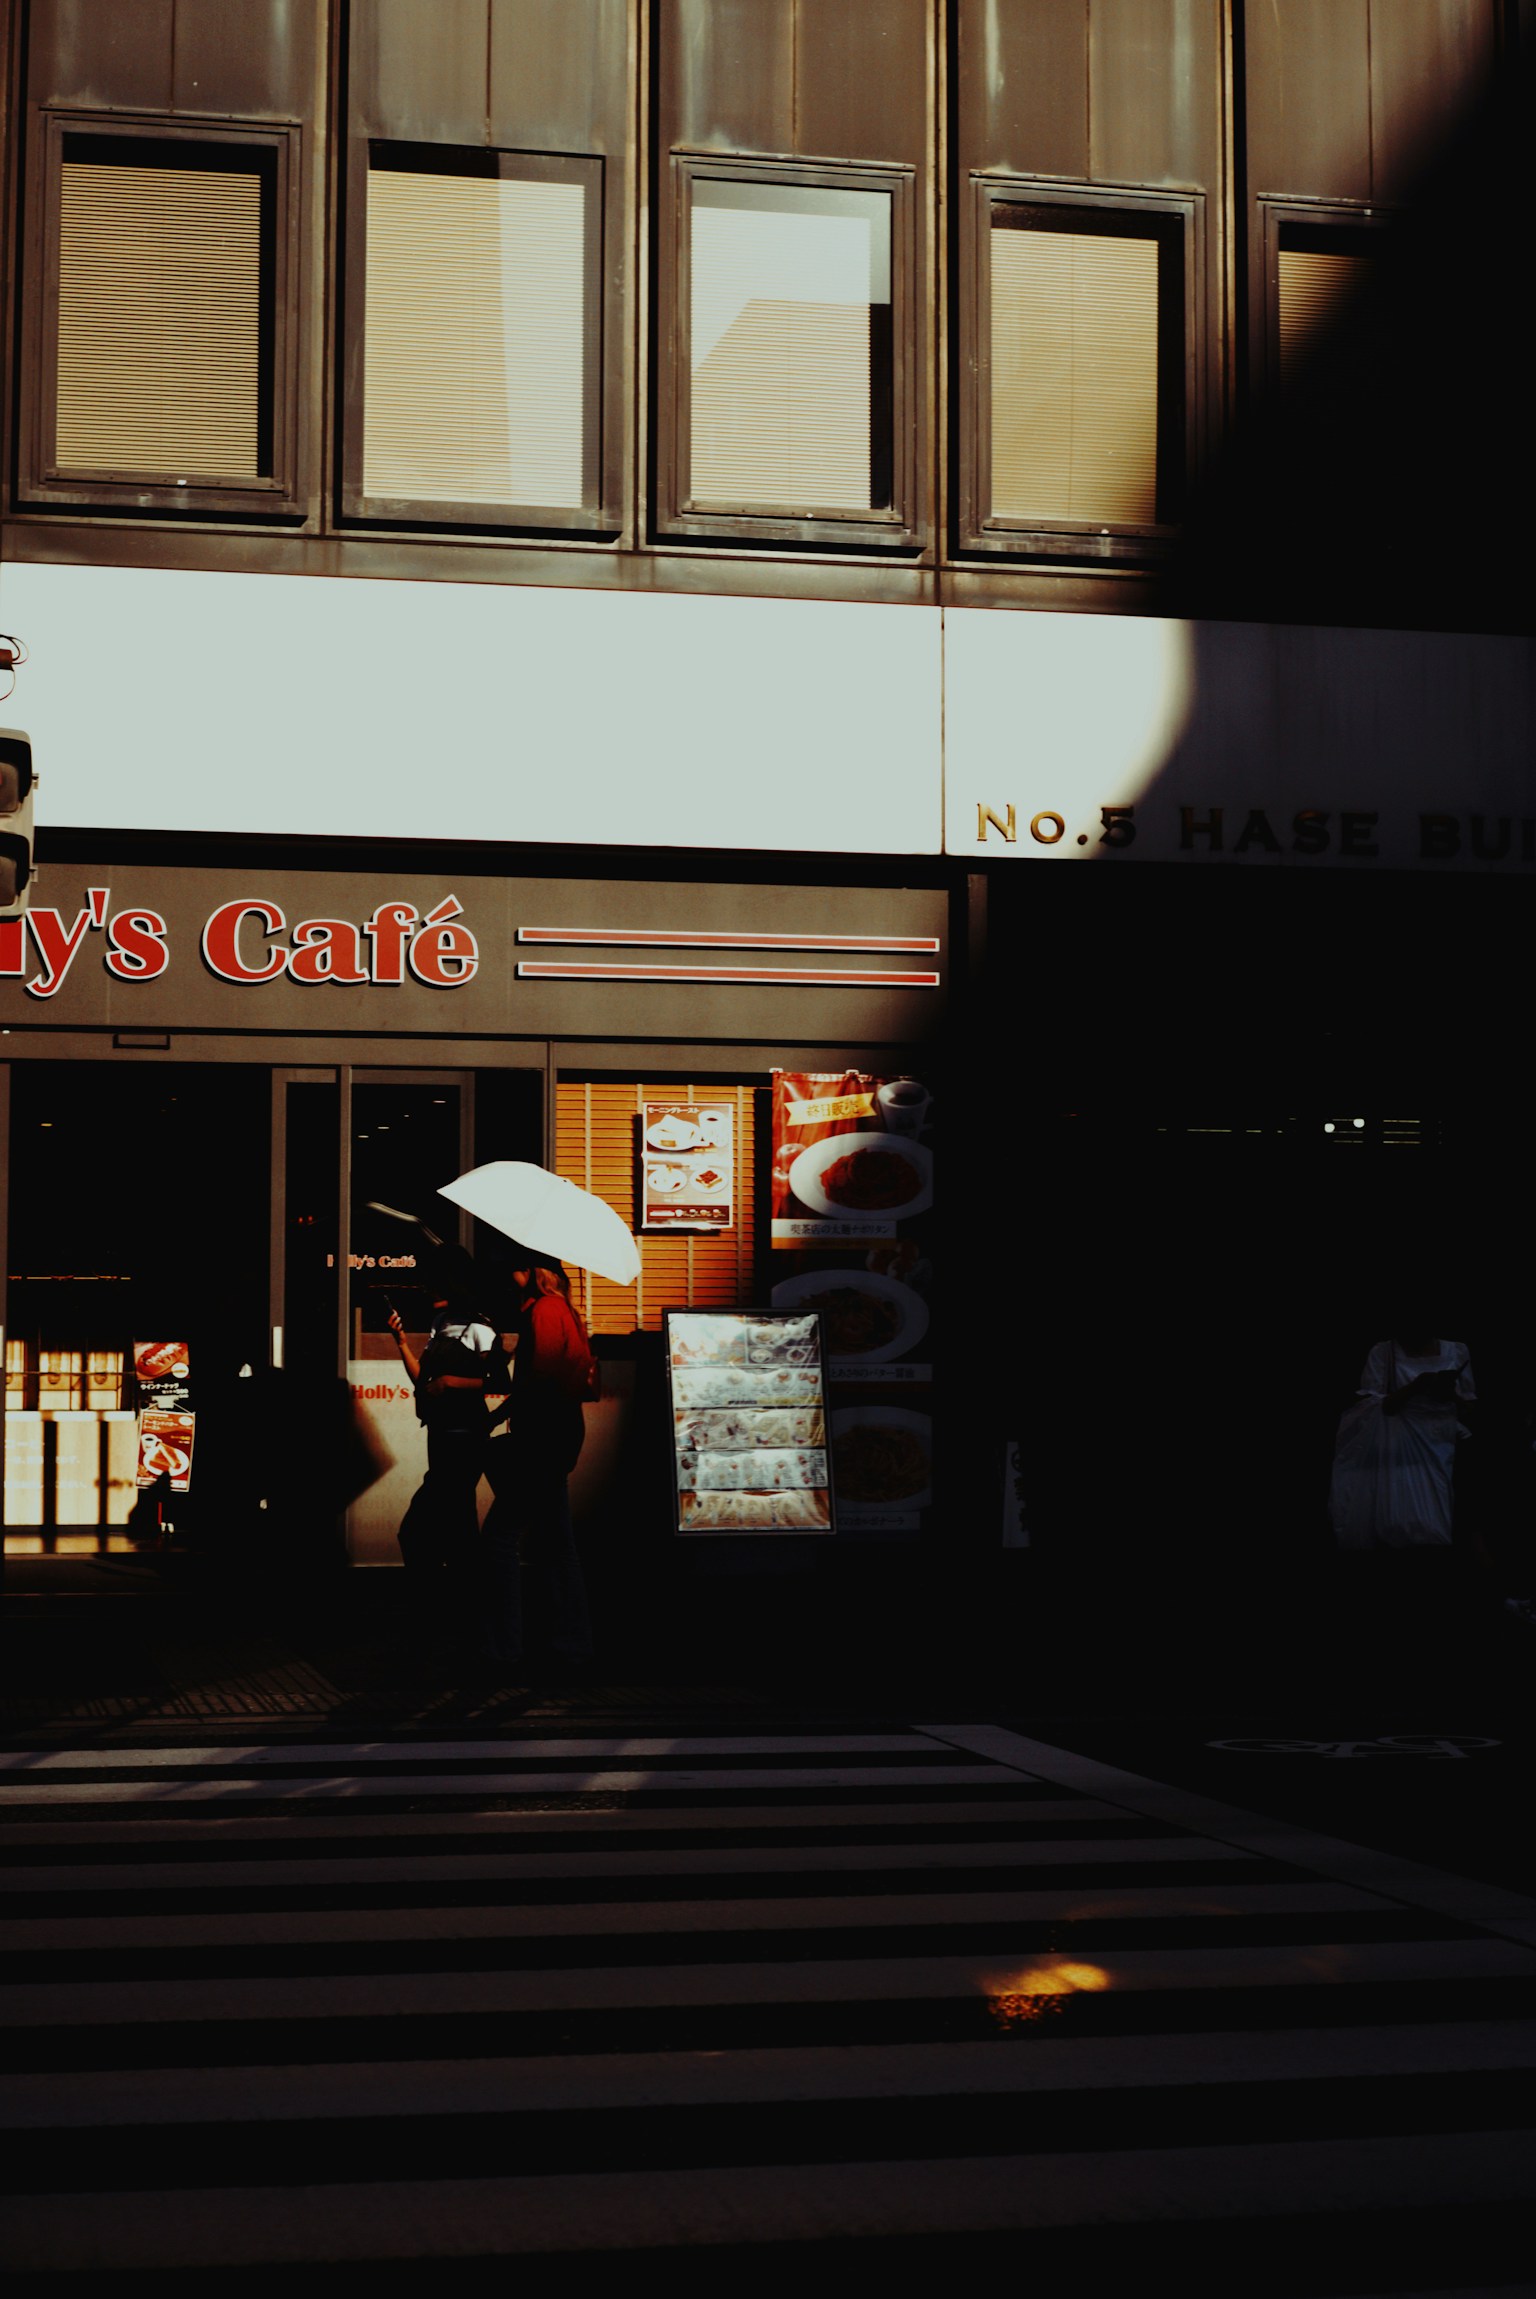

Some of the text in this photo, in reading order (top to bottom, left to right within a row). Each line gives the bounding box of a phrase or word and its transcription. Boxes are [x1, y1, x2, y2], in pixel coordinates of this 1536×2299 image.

[977, 803, 1136, 848] No.5
[1180, 806, 1380, 857] HASE
[202, 893, 480, 987] Café
[378, 1254, 417, 1268] Café
[351, 1384, 410, 1402] Holly's
